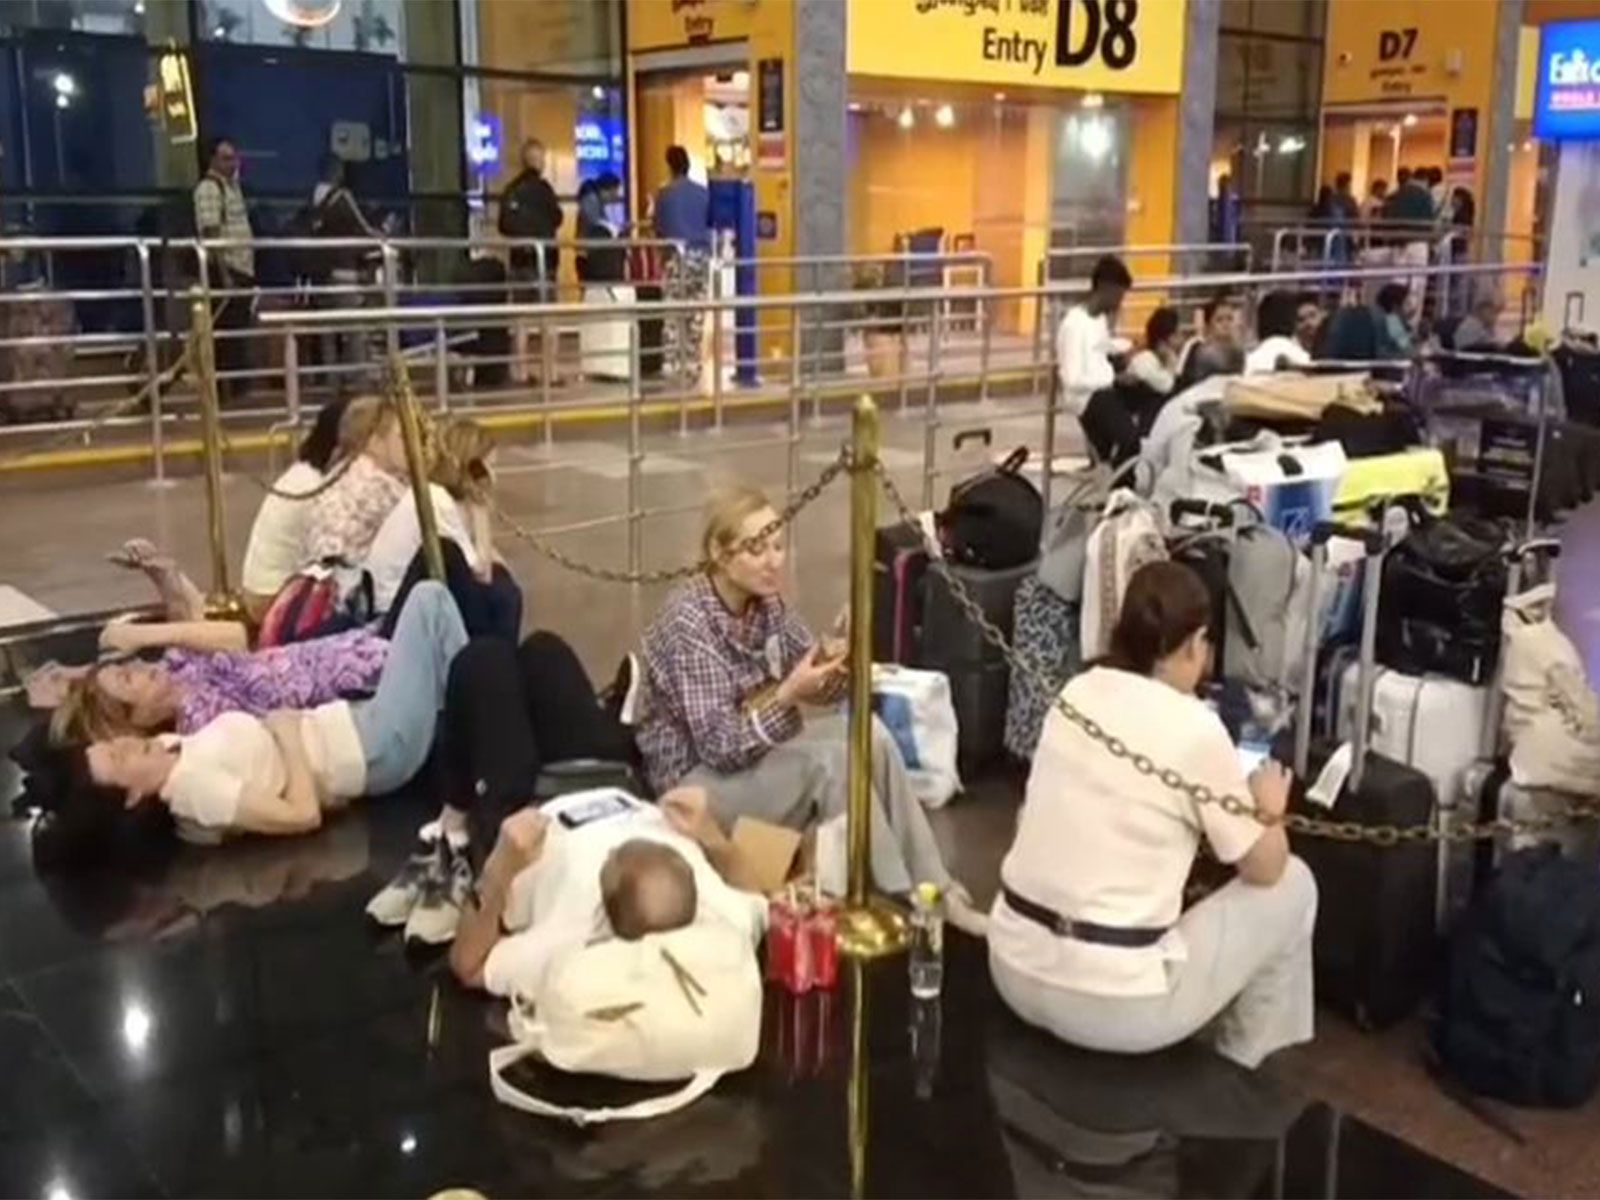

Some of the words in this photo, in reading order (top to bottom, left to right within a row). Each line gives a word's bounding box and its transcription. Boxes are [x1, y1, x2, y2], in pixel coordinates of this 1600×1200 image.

[982, 27, 1047, 75] Entry
[1055, 0, 1137, 70] D8
[1379, 28, 1418, 61] D7
